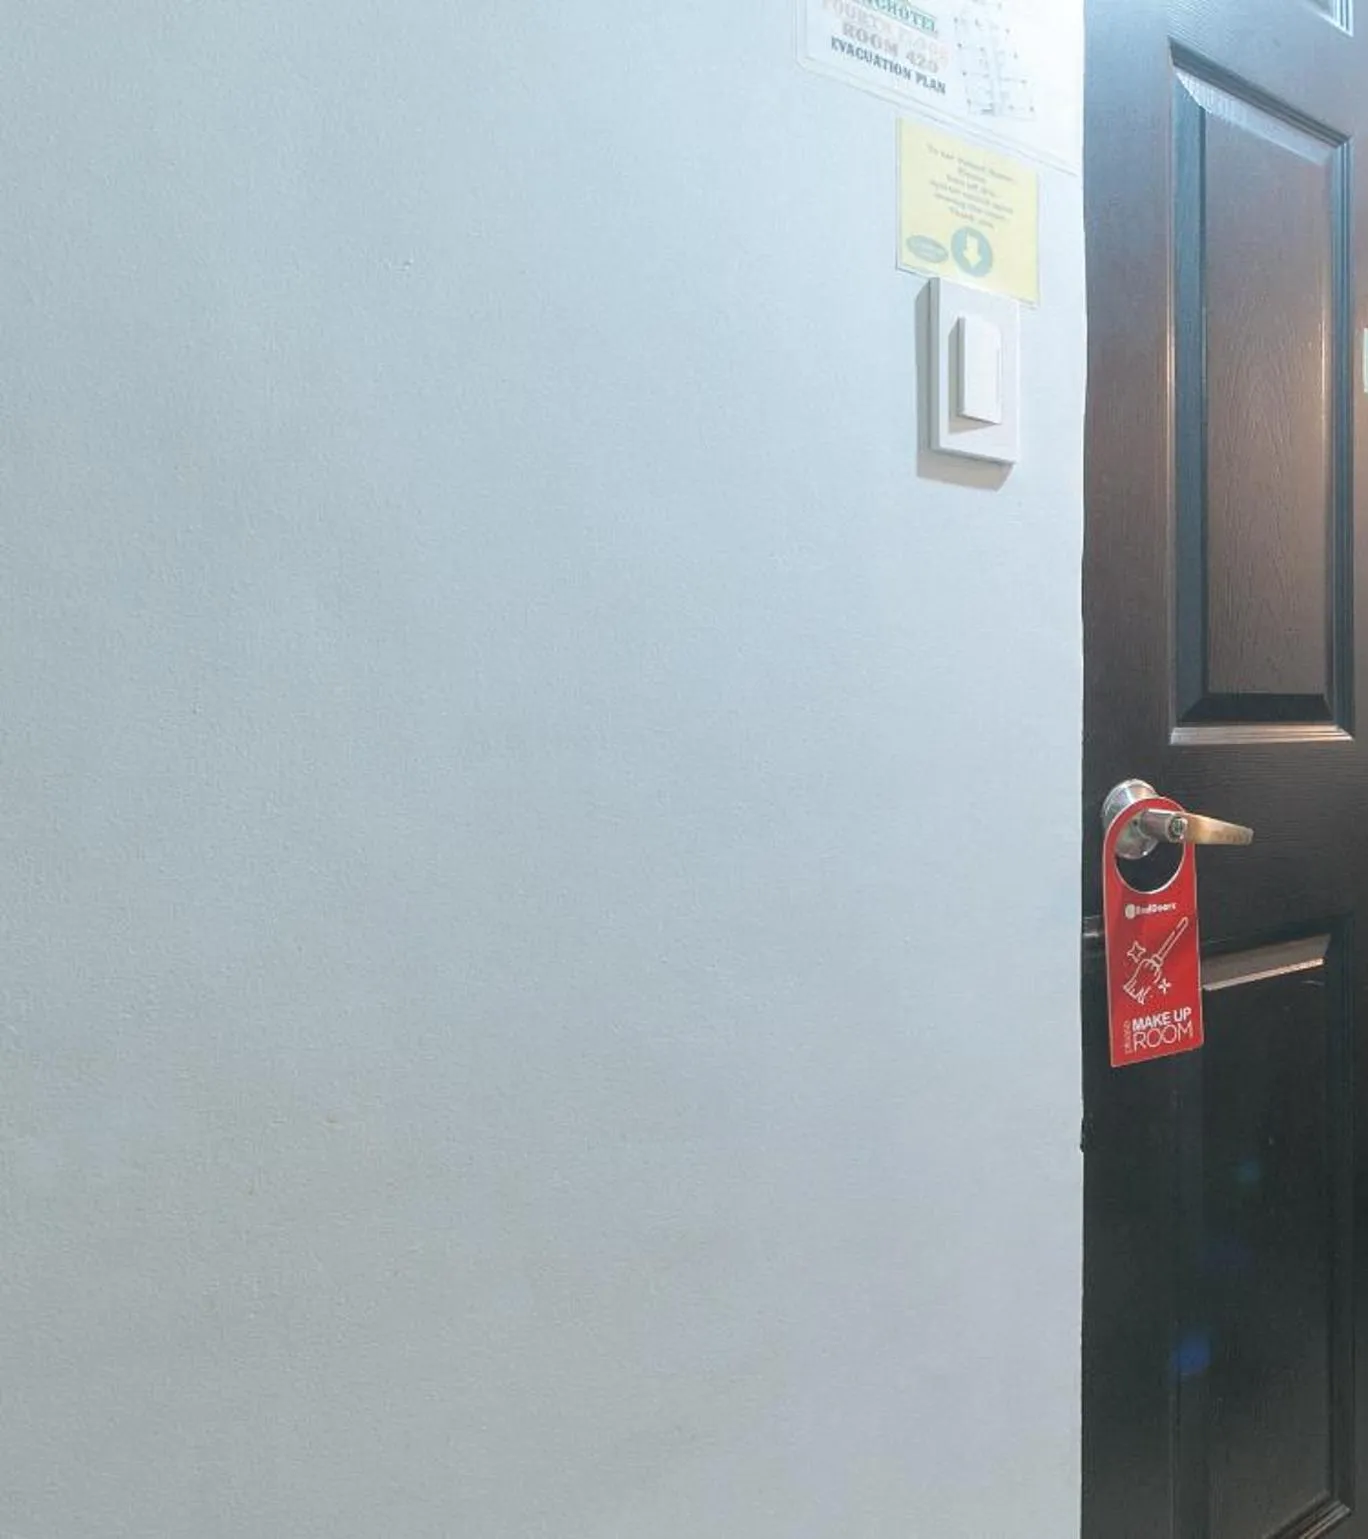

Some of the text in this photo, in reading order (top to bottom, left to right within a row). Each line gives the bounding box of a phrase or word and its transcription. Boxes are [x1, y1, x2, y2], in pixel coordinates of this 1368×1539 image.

[843, 21, 898, 56] ROOM
[831, 36, 946, 94] EVACUATION PLAN
[1132, 1006, 1192, 1032] MAKE UP
[1133, 1020, 1193, 1052] ROOM
